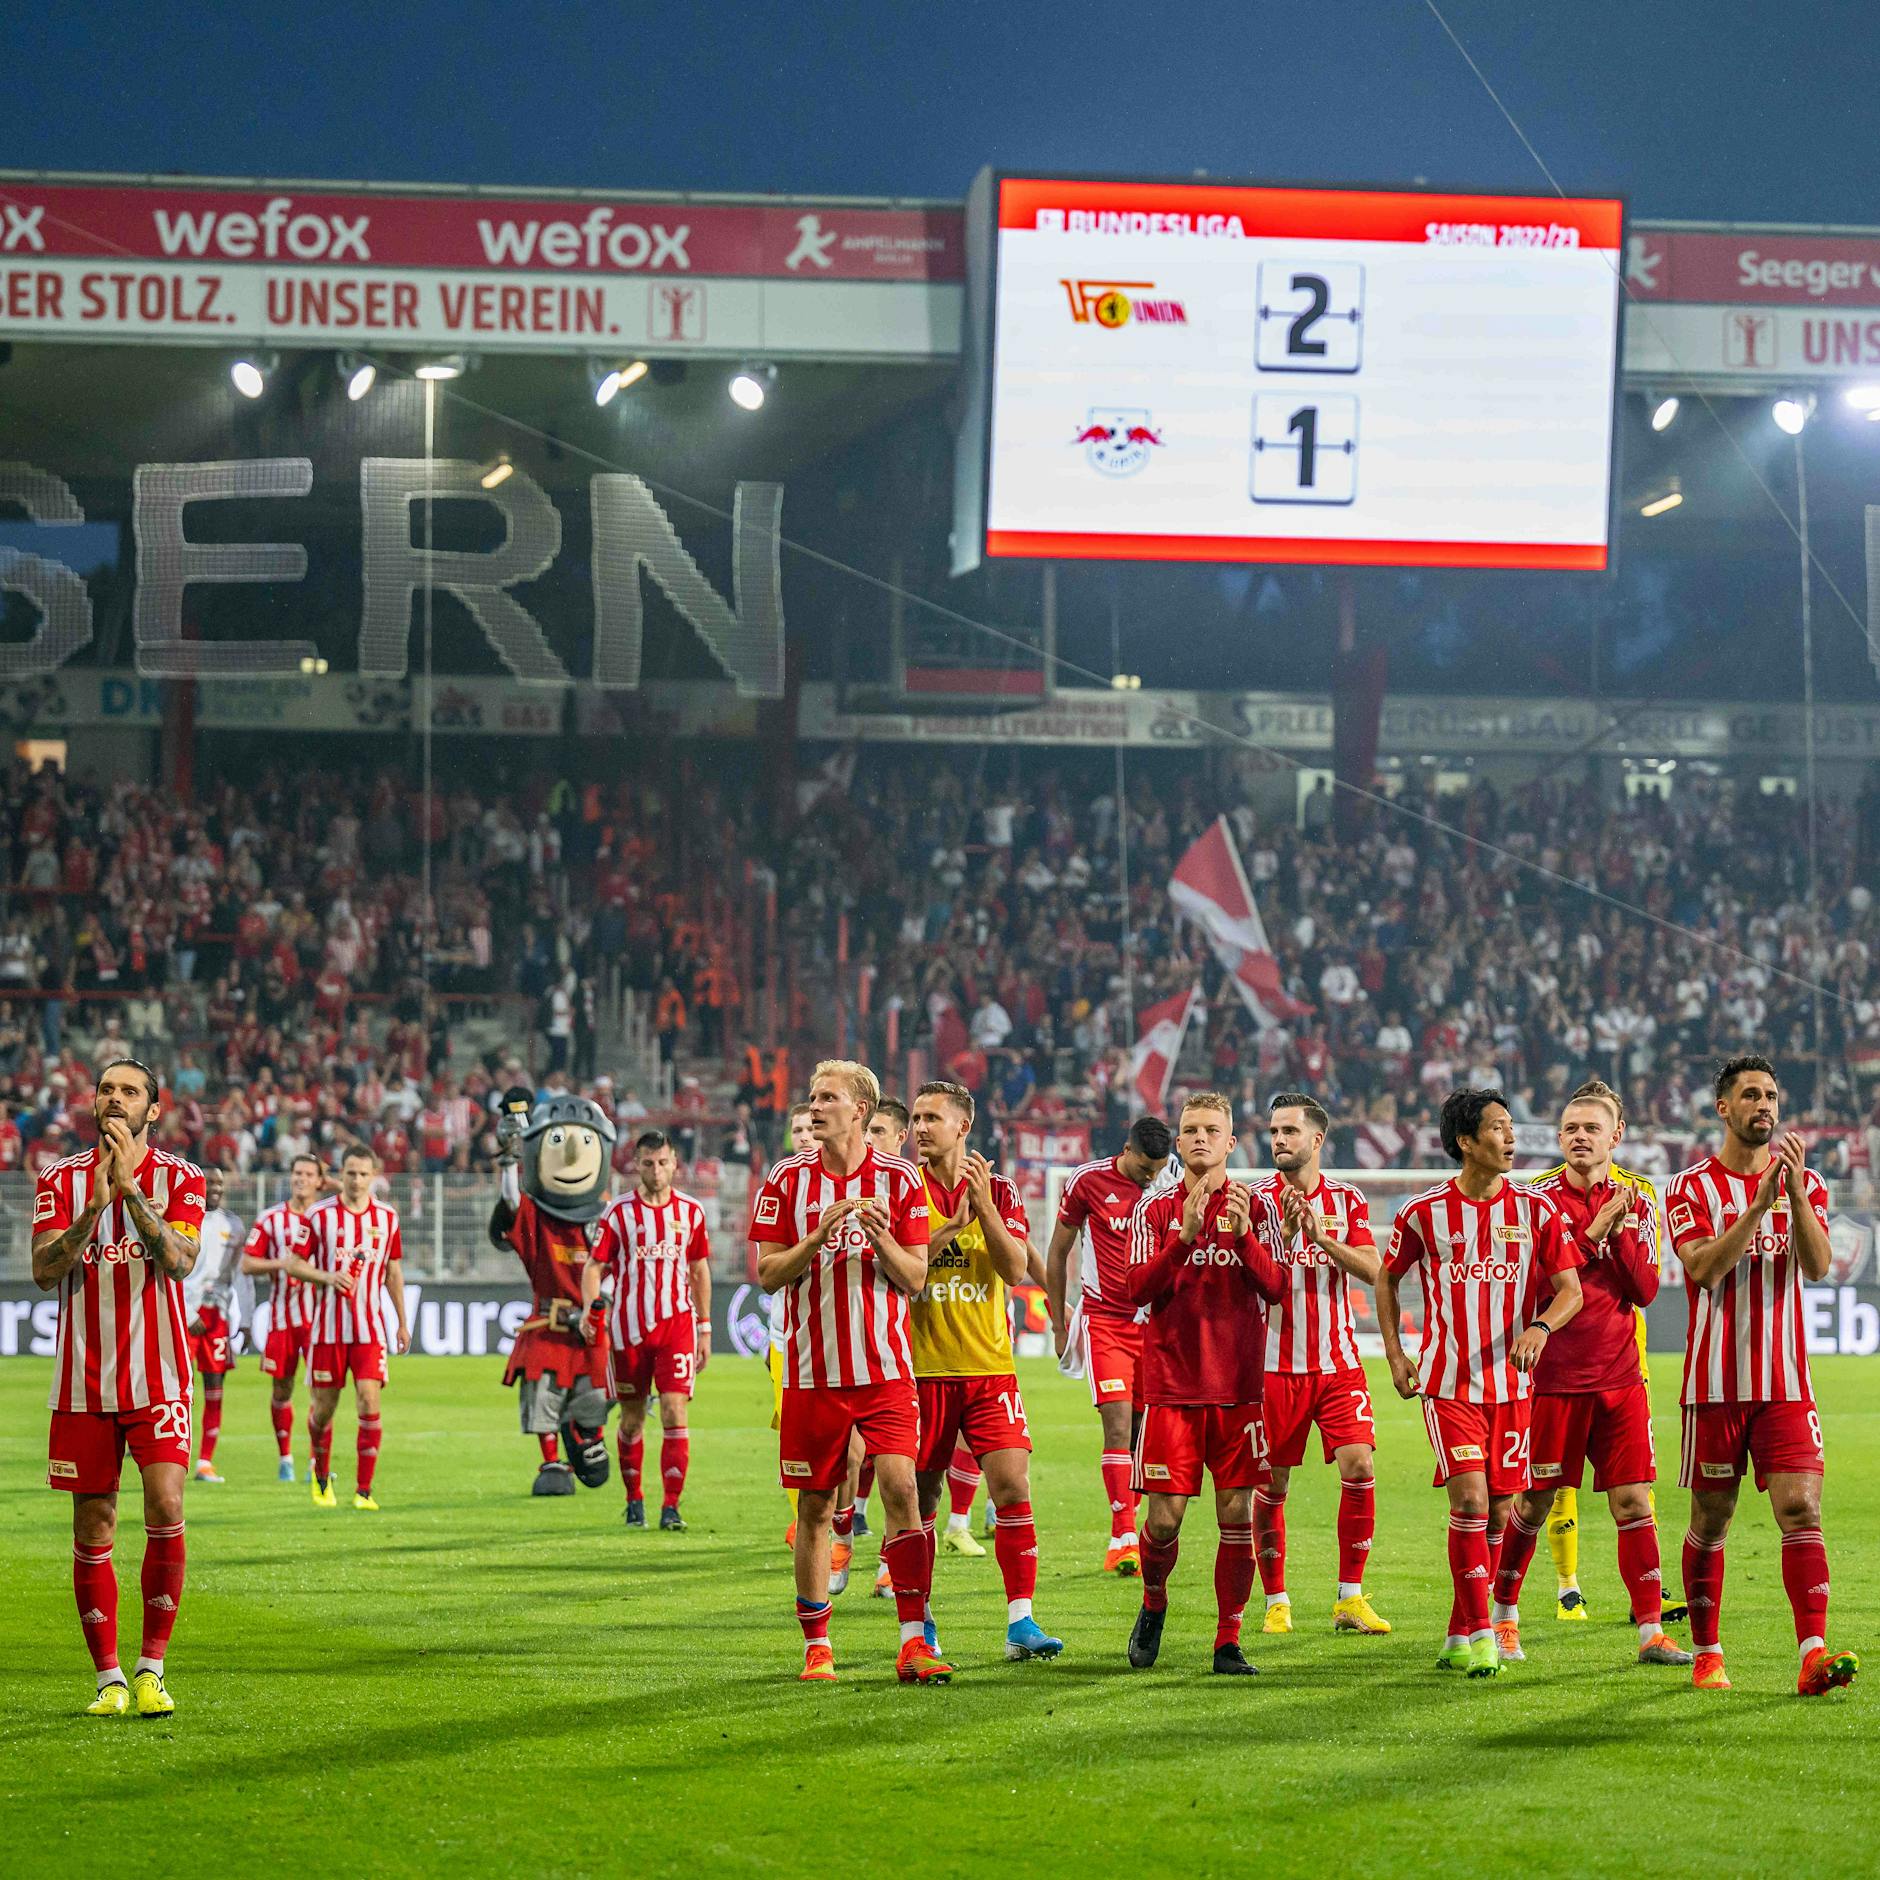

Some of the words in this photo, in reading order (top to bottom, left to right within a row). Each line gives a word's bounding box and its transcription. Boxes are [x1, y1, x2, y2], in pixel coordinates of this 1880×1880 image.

[154, 199, 371, 260] wefox
[477, 208, 689, 269] wefox
[1068, 210, 1245, 238] BUNDESLIGA
[1737, 250, 1867, 295] Seeger
[0, 271, 64, 319] ER
[80, 272, 236, 323] STOLZ.
[267, 279, 420, 329] UNSER
[440, 284, 620, 335] VEREIN.
[1286, 274, 1332, 355] 2
[1287, 405, 1318, 487] 1
[82, 1235, 153, 1264] wefo
[1448, 1256, 1521, 1282] wefox
[673, 1352, 694, 1378] 31
[150, 1401, 190, 1440] 28
[997, 1391, 1027, 1425] 14
[1244, 1420, 1269, 1459] 13
[1807, 1410, 1823, 1449] 8
